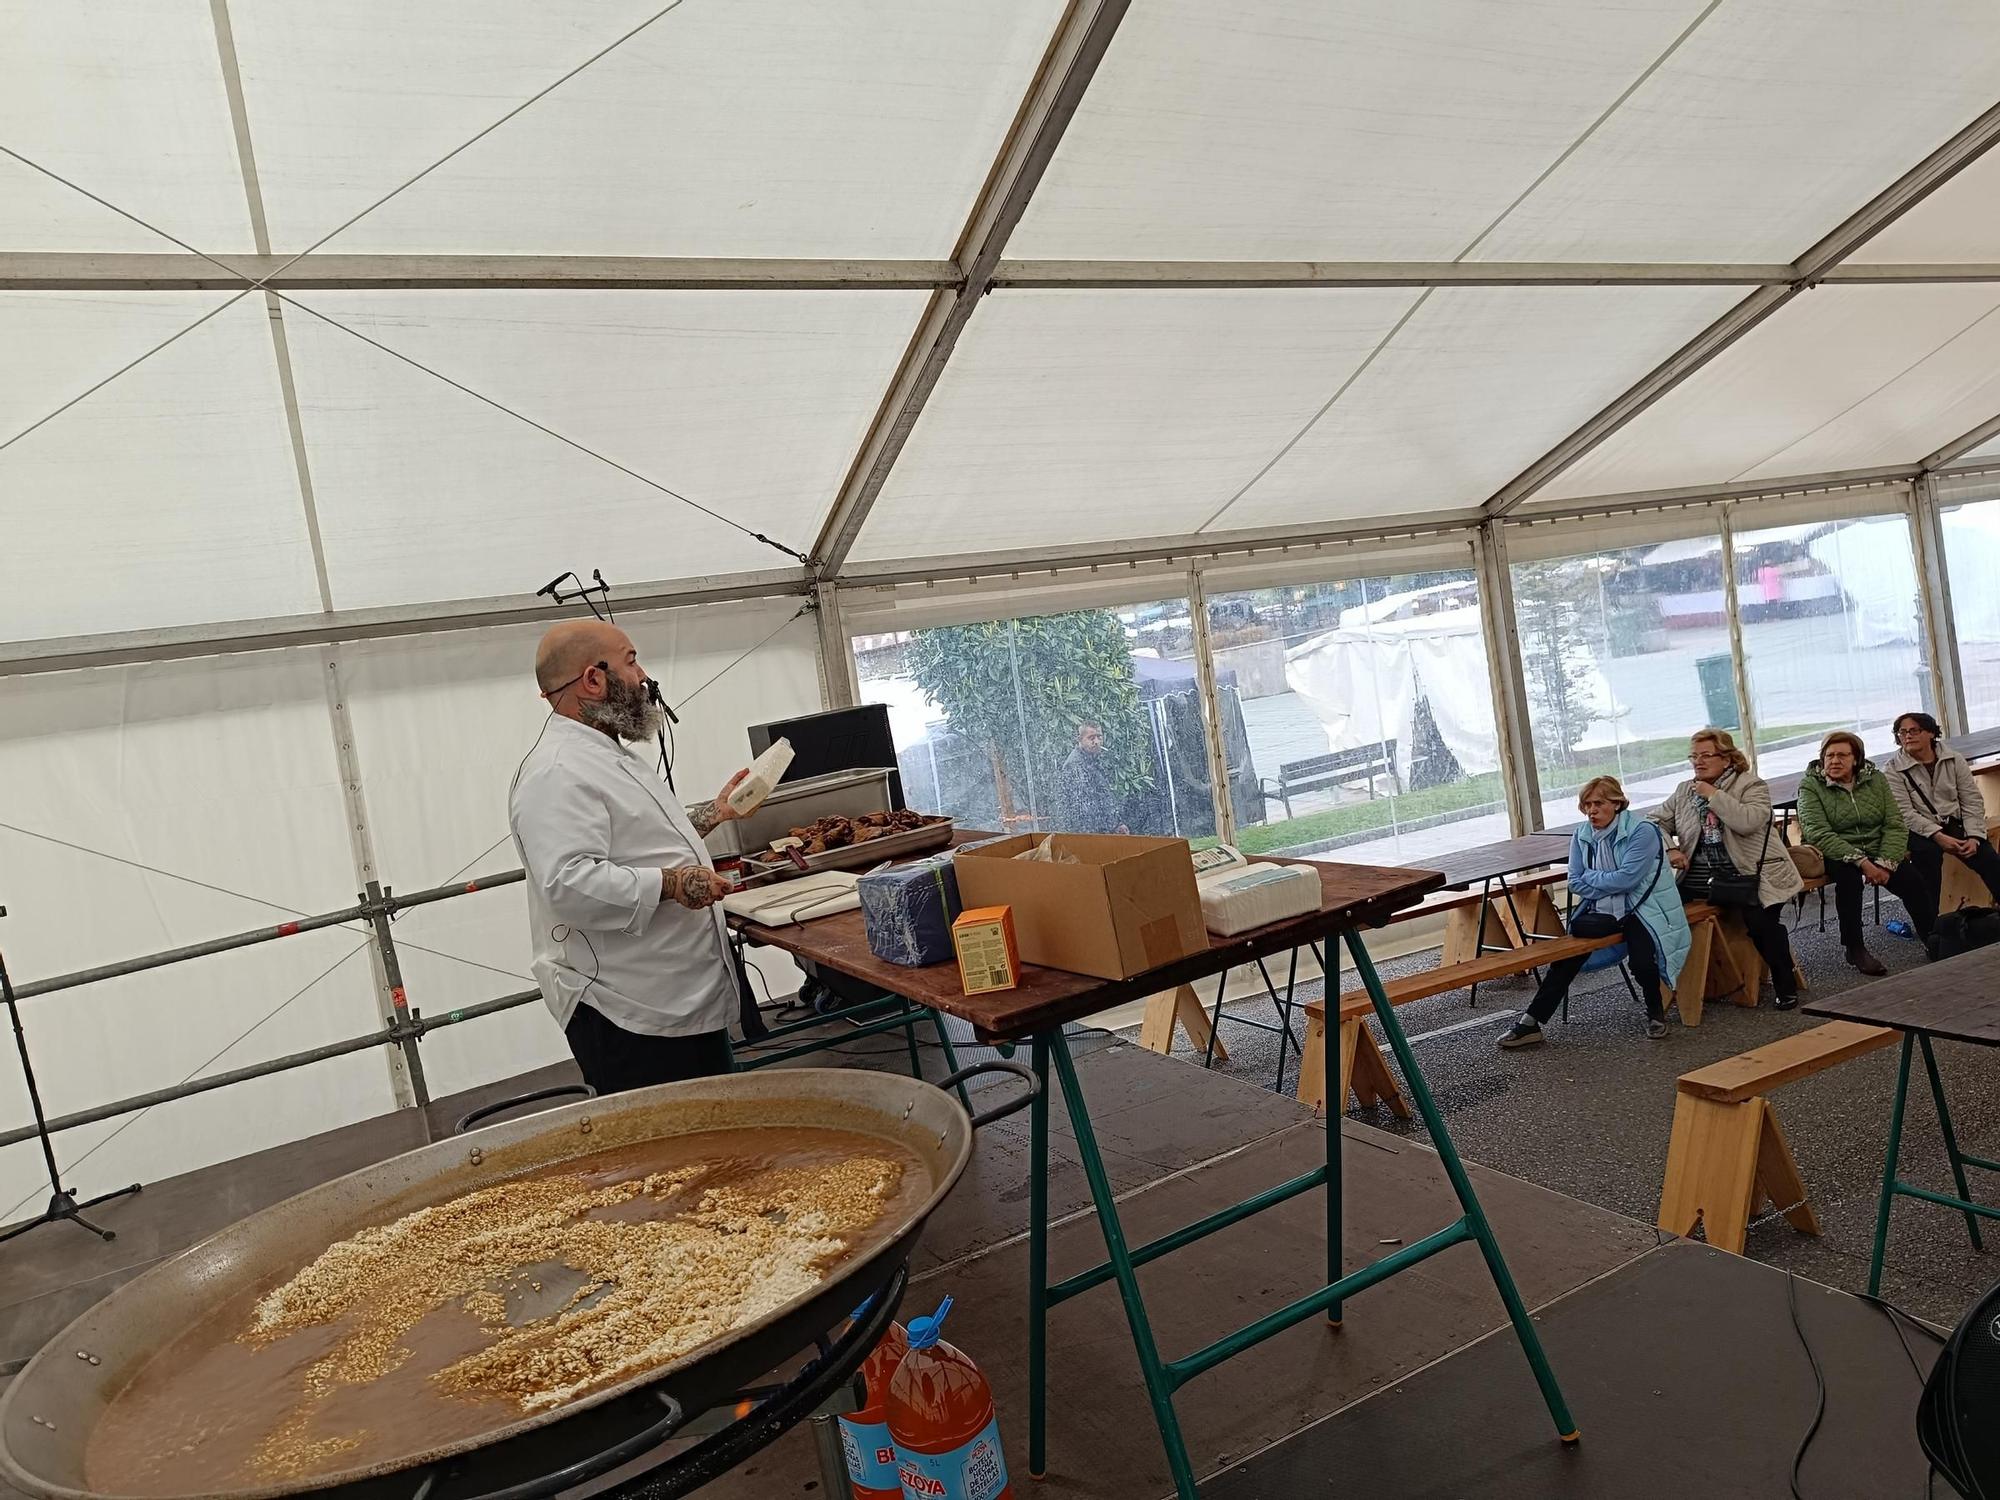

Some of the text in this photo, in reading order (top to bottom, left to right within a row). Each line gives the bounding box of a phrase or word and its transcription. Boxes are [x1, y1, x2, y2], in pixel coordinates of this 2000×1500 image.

[968, 1449, 994, 1475] BOTELLA
[969, 1478, 980, 1489] DE
[979, 1460, 999, 1482] OTRAS
[972, 1459, 994, 1479] HECHA
[899, 1467, 946, 1495] EZOYA
[970, 1468, 1000, 1496] BOTELLAS
